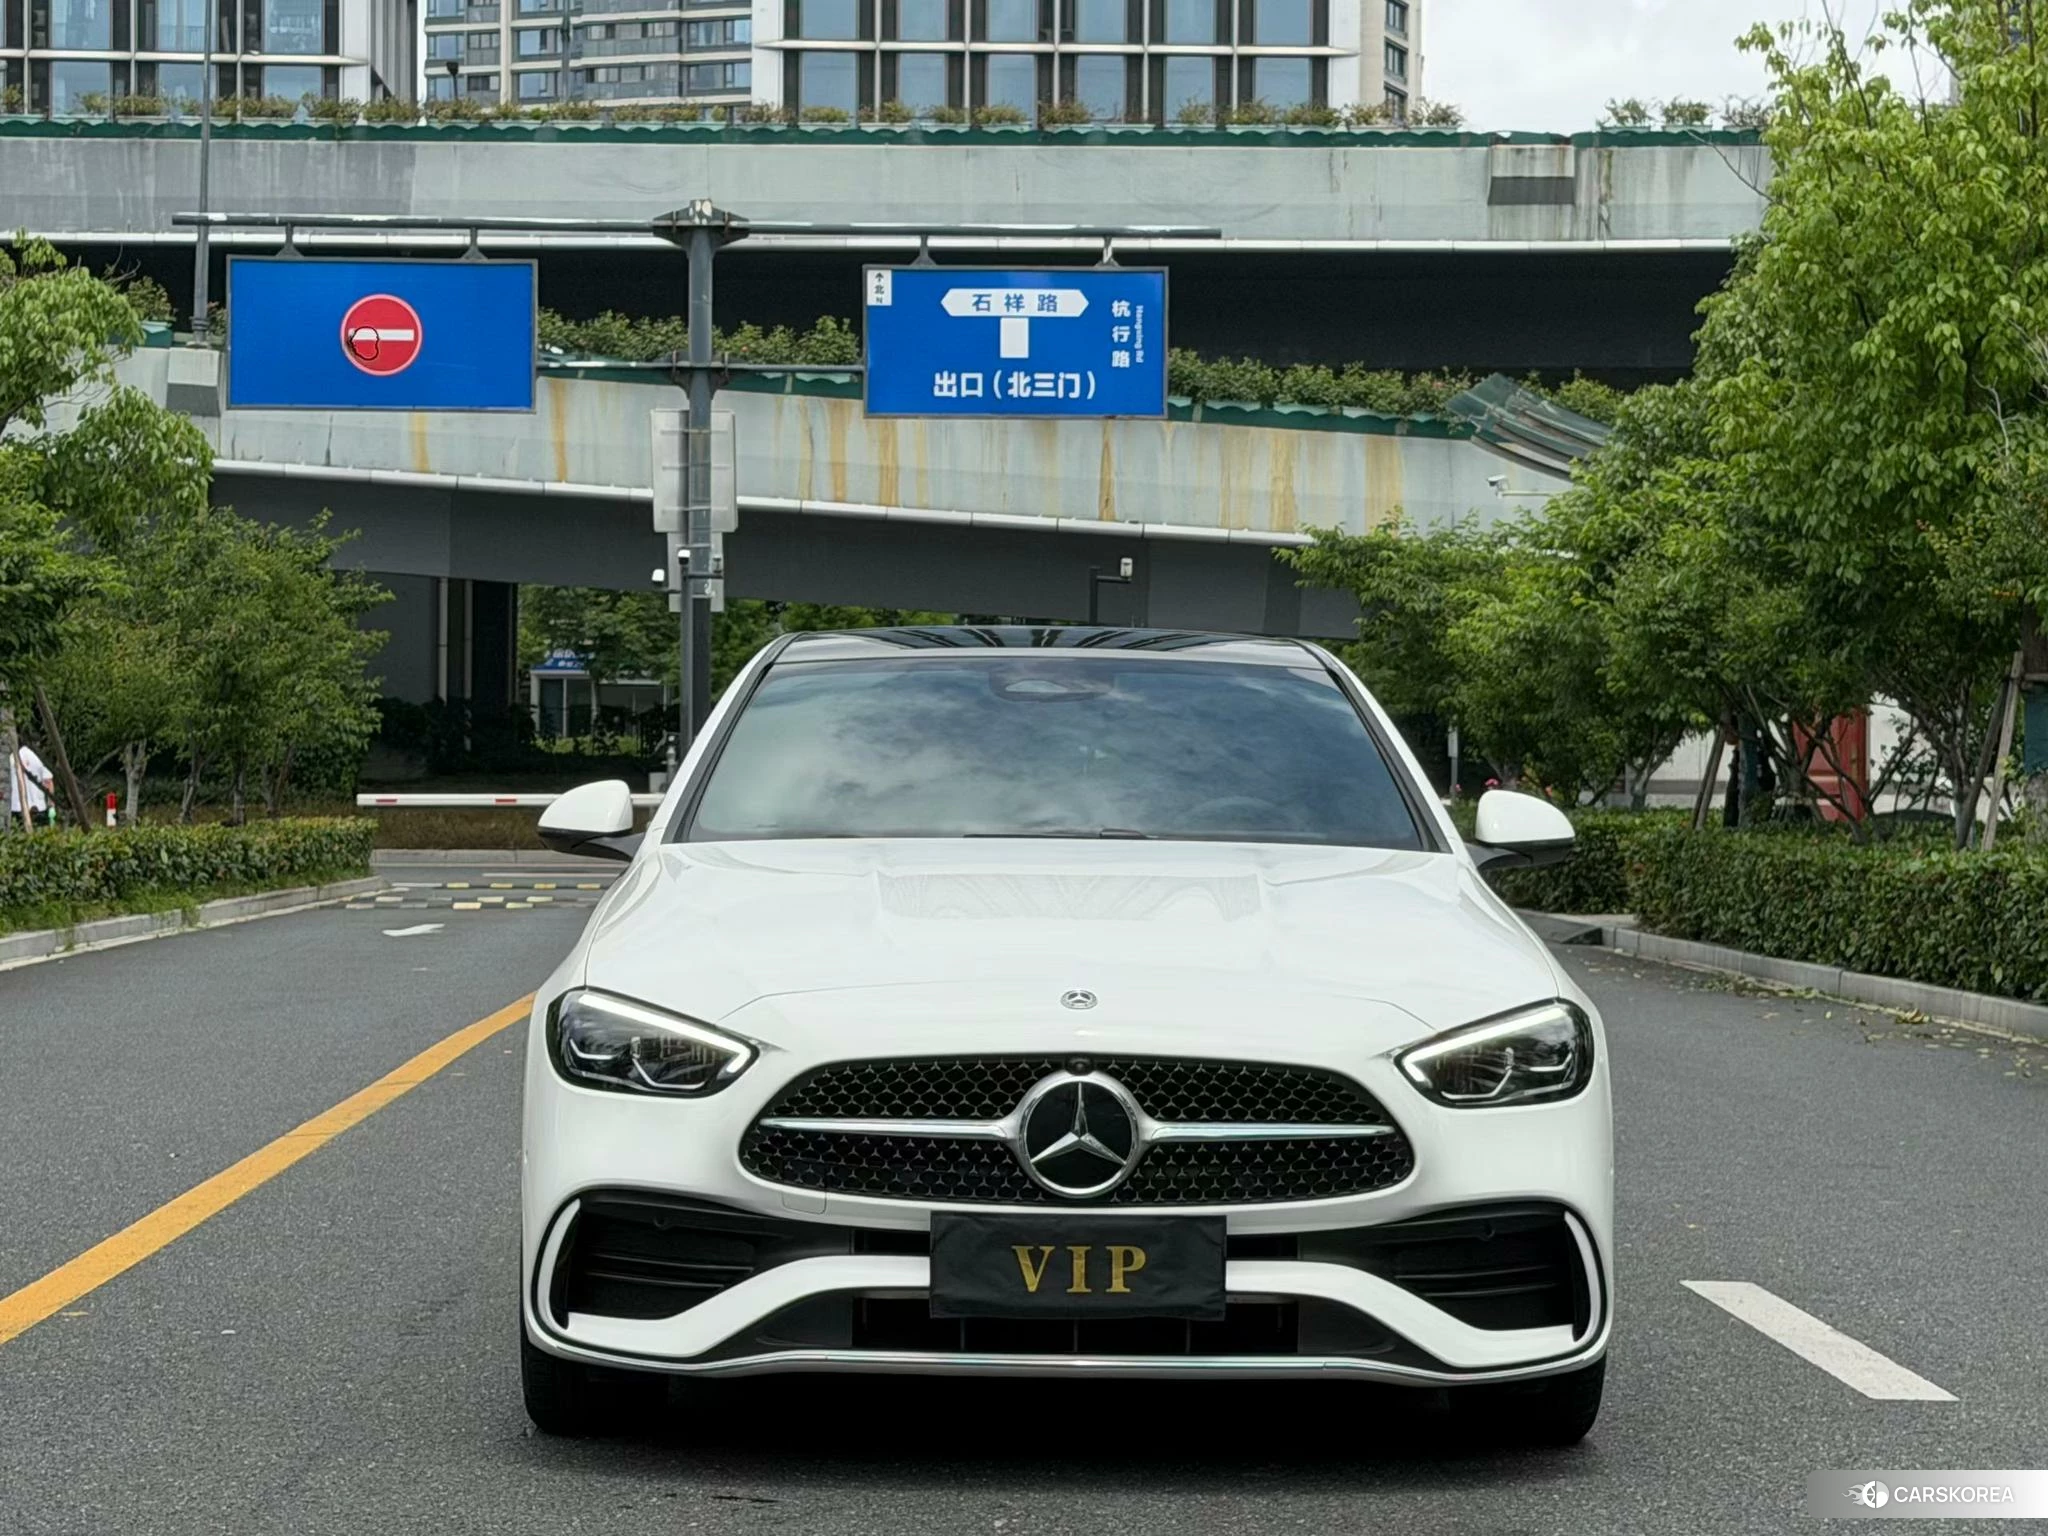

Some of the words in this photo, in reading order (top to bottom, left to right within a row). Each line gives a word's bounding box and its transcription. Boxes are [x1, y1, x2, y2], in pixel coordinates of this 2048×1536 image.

[874, 284, 885, 295] 北
[971, 293, 1058, 313] 石祥路
[1111, 299, 1131, 368] 杭行路
[1011, 1245, 1147, 1293] VIP
